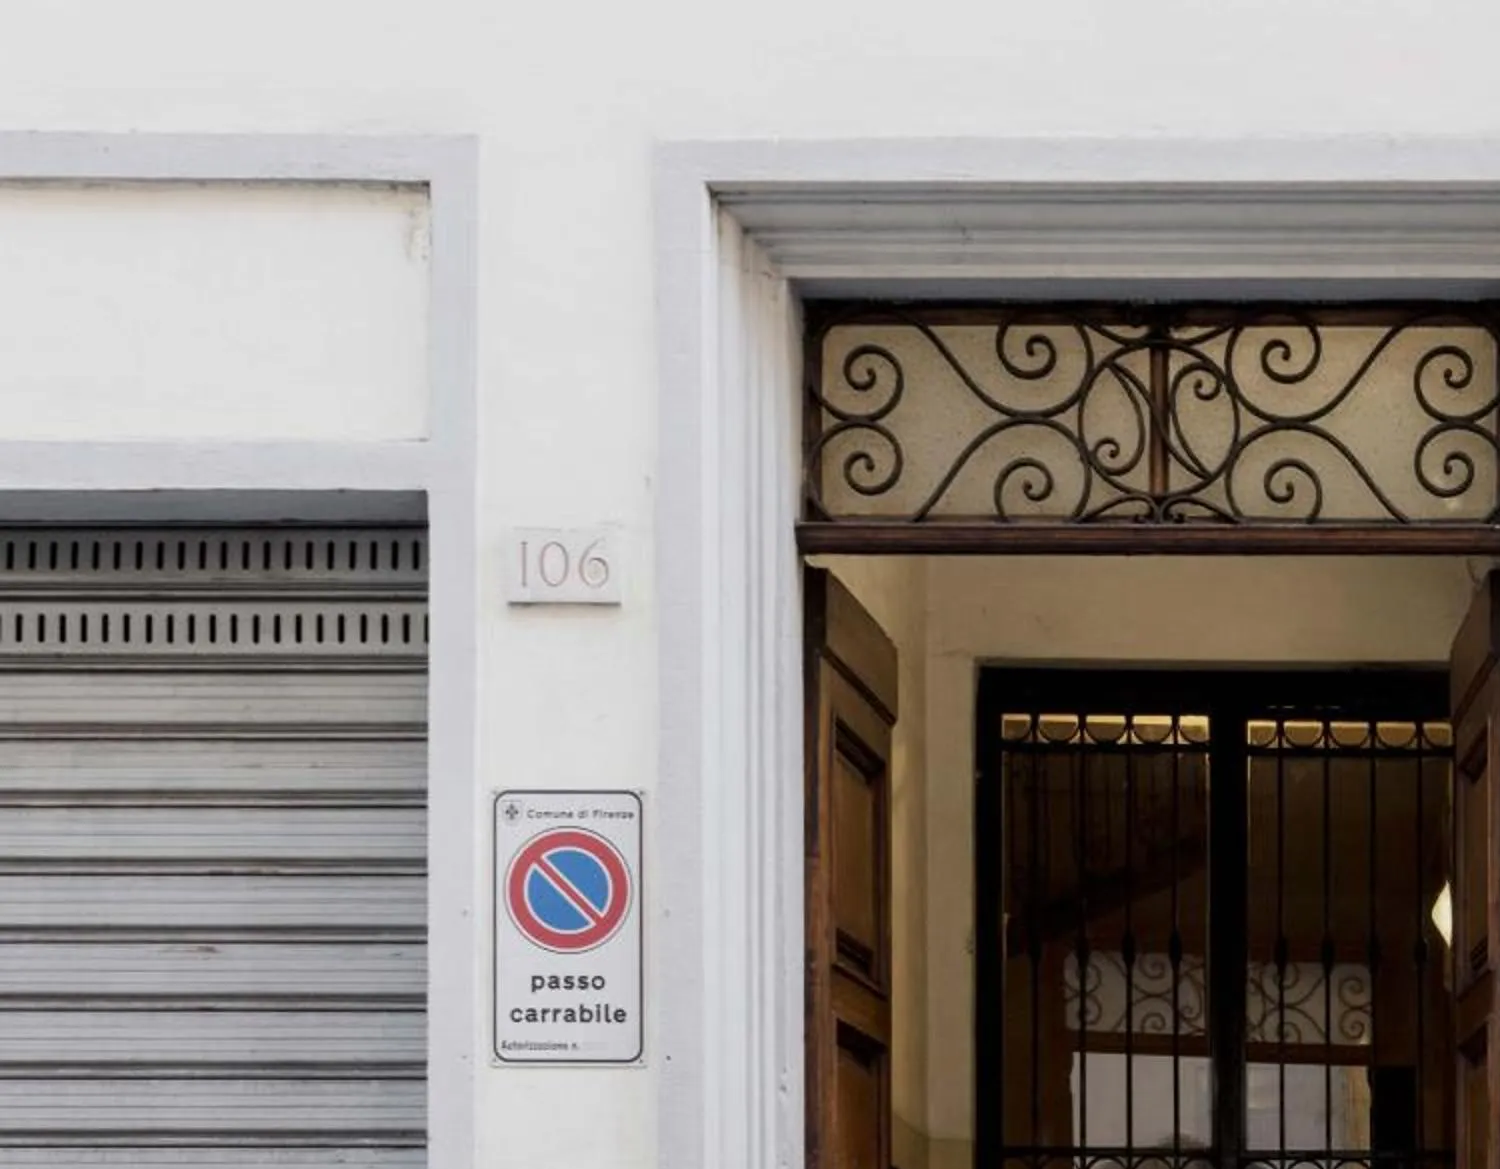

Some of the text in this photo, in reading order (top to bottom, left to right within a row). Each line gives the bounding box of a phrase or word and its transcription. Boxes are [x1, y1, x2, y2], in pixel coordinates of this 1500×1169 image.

[519, 537, 610, 588] 106
[526, 808, 635, 819] Comune di Firenze
[531, 975, 605, 993] passo
[509, 1003, 627, 1023] carrabile
